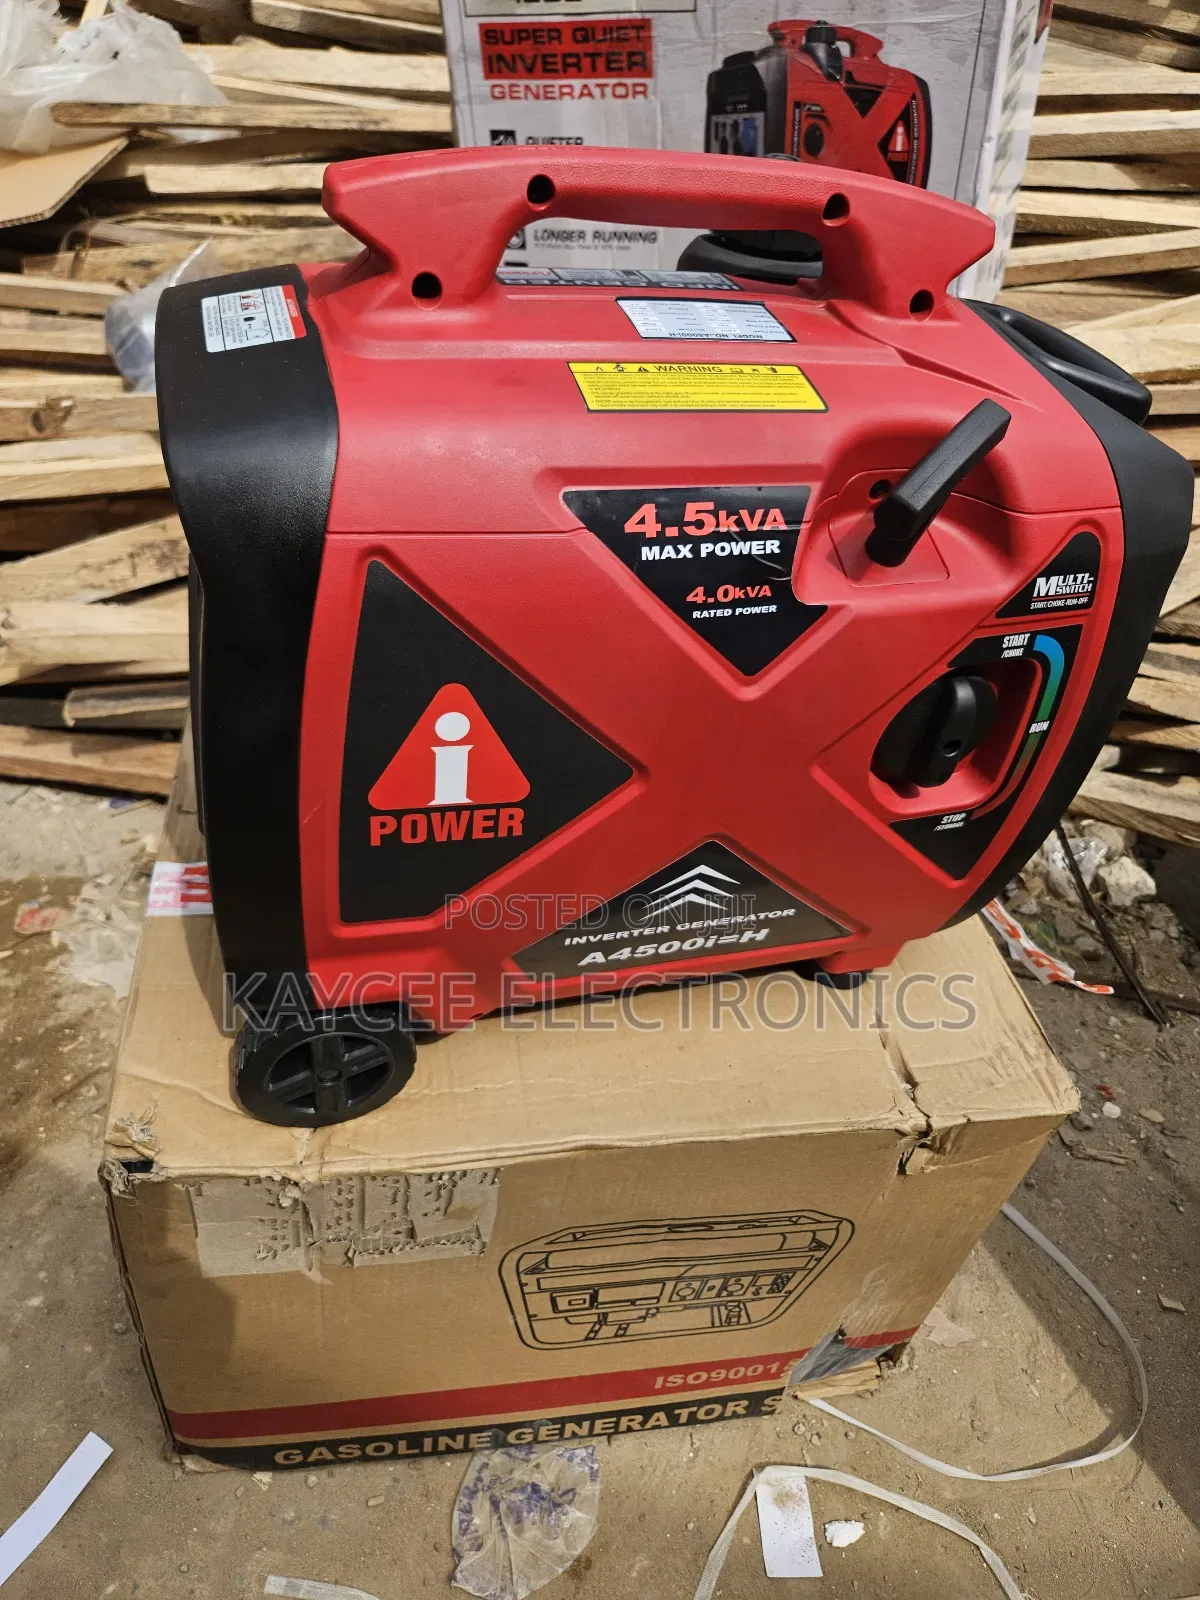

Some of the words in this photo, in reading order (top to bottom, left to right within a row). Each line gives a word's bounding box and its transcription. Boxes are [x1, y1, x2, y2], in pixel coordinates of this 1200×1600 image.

[484, 27, 561, 46] SUPER
[572, 24, 645, 44] QUIET
[488, 52, 648, 75] INVERTER
[490, 82, 649, 101] GENERATOR
[534, 229, 586, 243] LONGER
[592, 229, 658, 244] RUNNING
[653, 365, 723, 374] WARNING
[623, 501, 788, 538] 4.5kVA
[641, 543, 693, 561] MAX
[700, 539, 780, 558] POWER
[686, 584, 772, 604] 4.0kVA
[1056, 583, 1092, 595] SWITCH
[693, 607, 732, 619] RATED
[735, 604, 777, 616] POWER
[1002, 633, 1031, 648] START
[1029, 720, 1050, 733] RUN
[370, 807, 525, 847] POWER
[941, 812, 967, 824] STOP
[564, 925, 671, 946] INVERTER
[676, 908, 797, 932] GENERATOR
[274, 1430, 493, 1466] GASOLINE
[507, 1399, 749, 1446] GENERATOR
